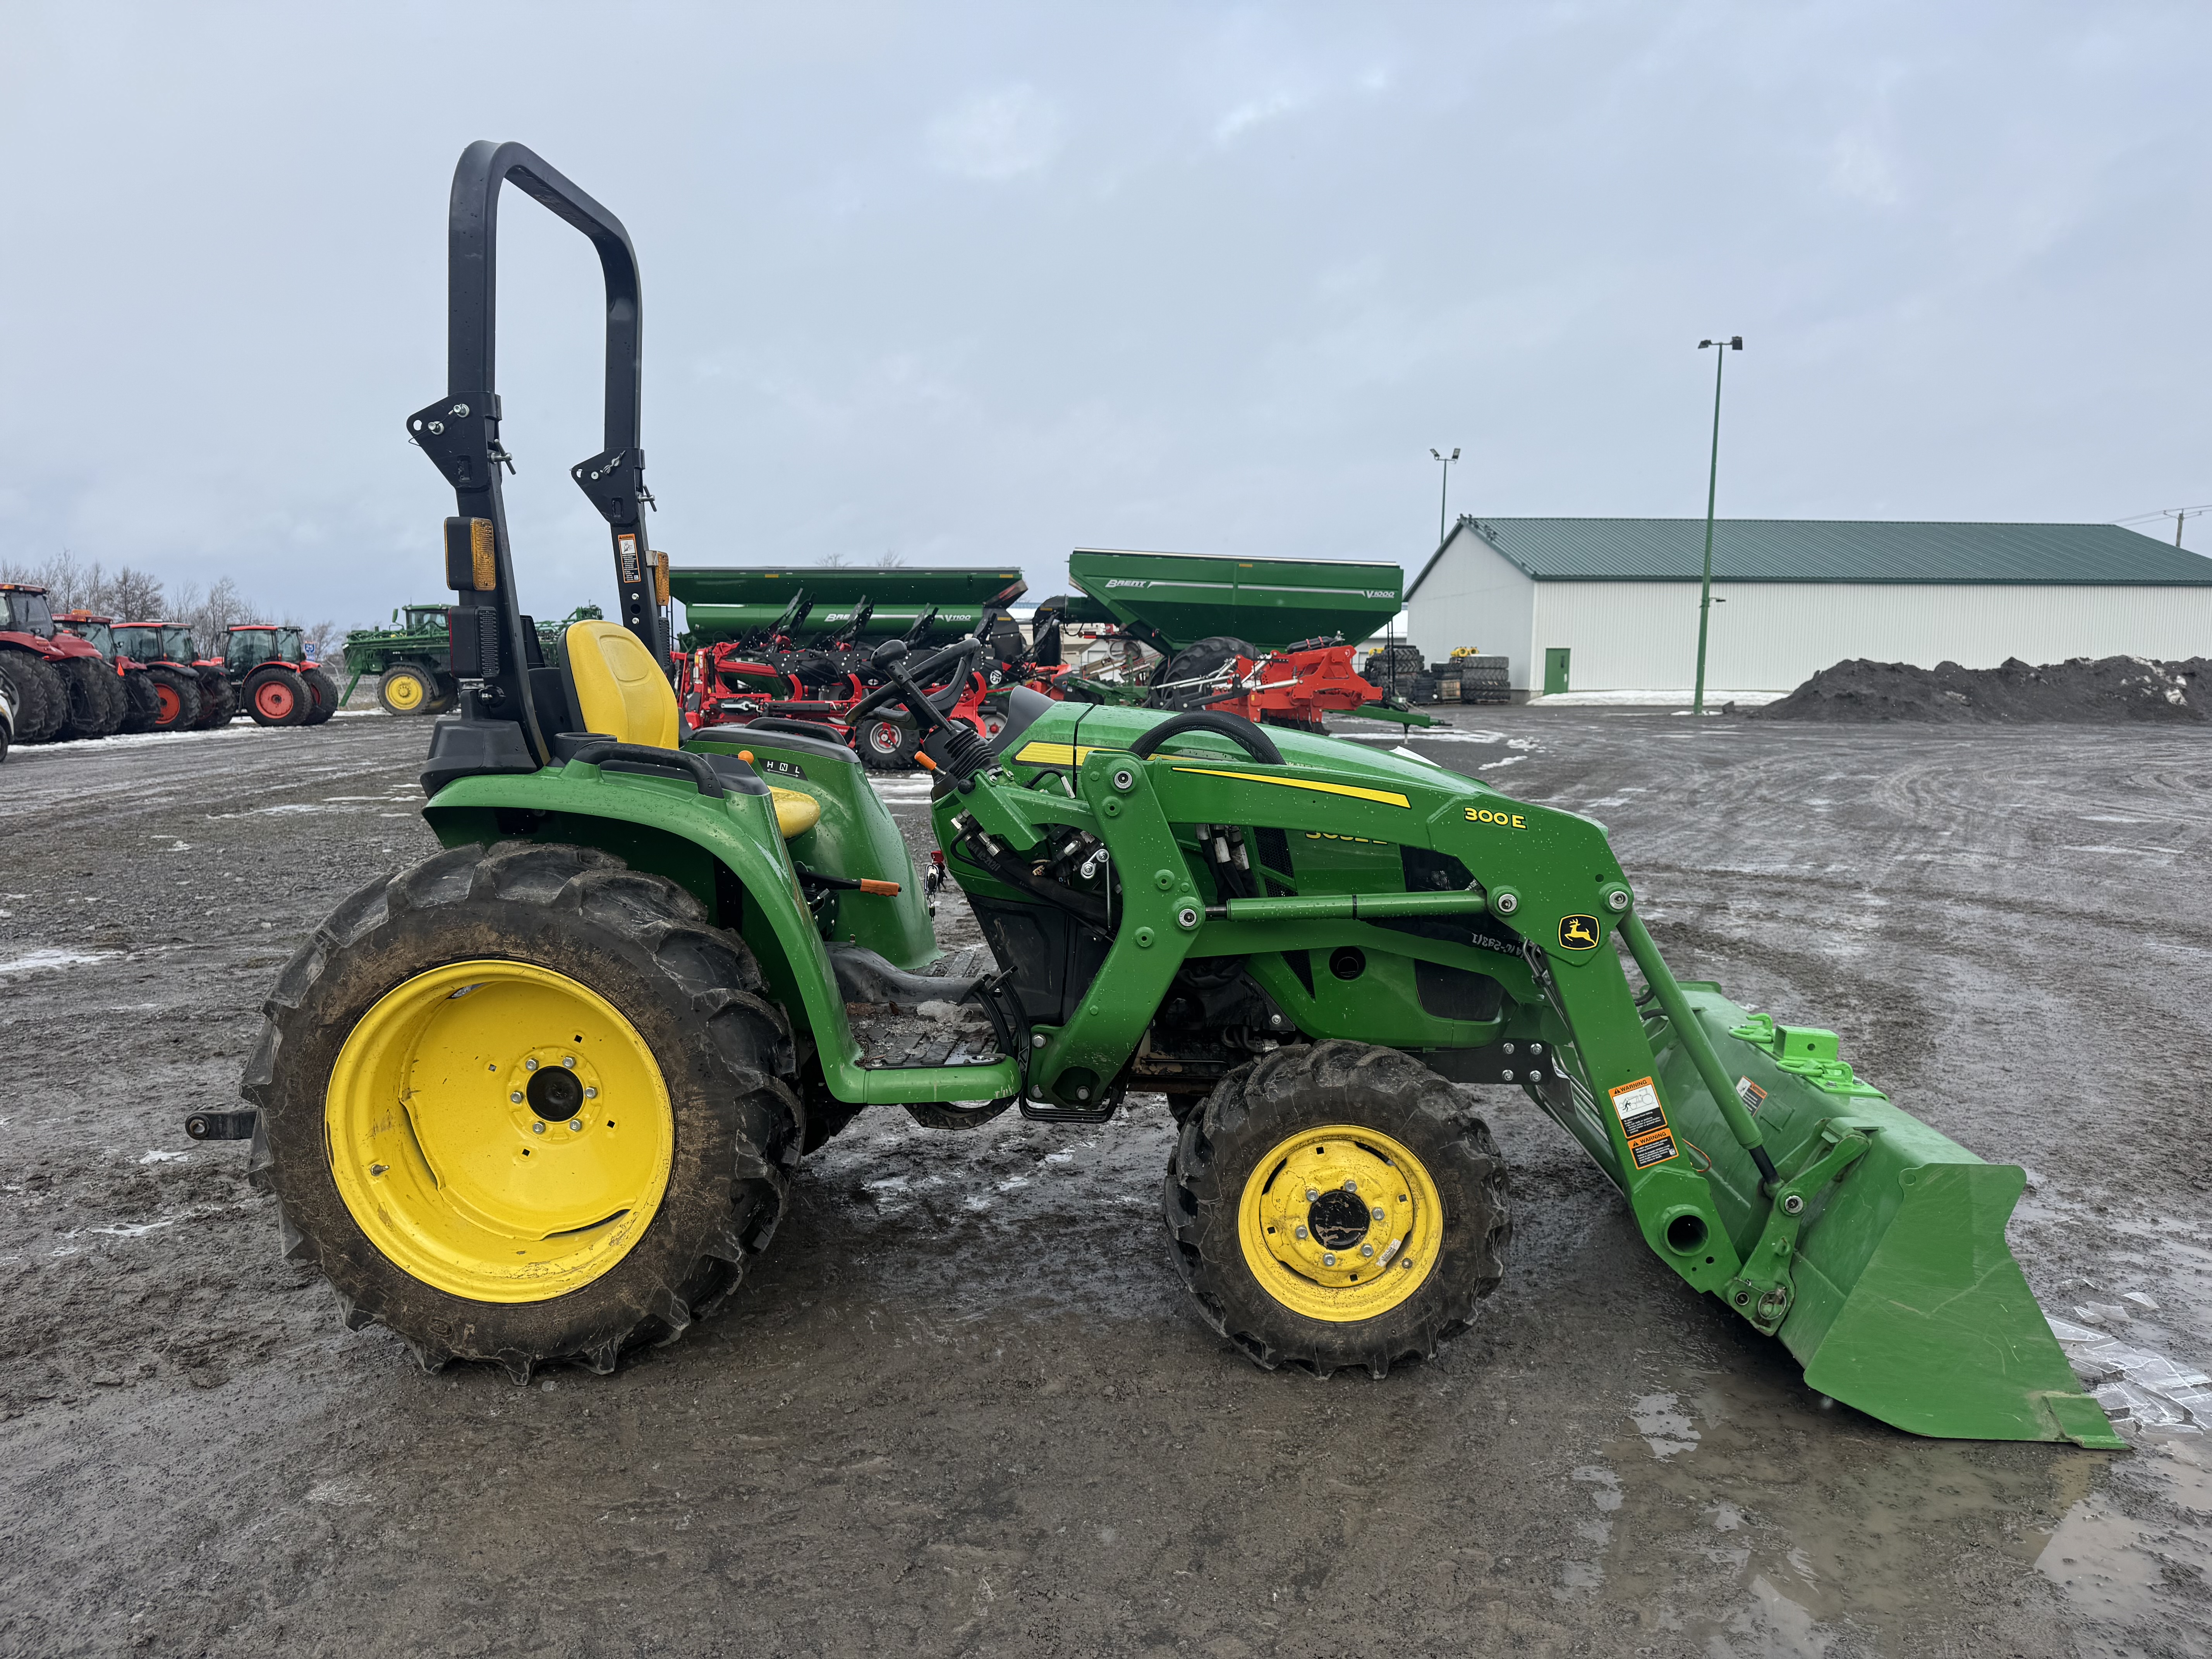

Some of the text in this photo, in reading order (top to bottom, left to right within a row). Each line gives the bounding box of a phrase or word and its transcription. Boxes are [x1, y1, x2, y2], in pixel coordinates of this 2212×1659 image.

[991, 672, 1001, 682] 25
[1620, 1080, 1647, 1092] WARNING
[1640, 1132, 1667, 1144] WARNING
